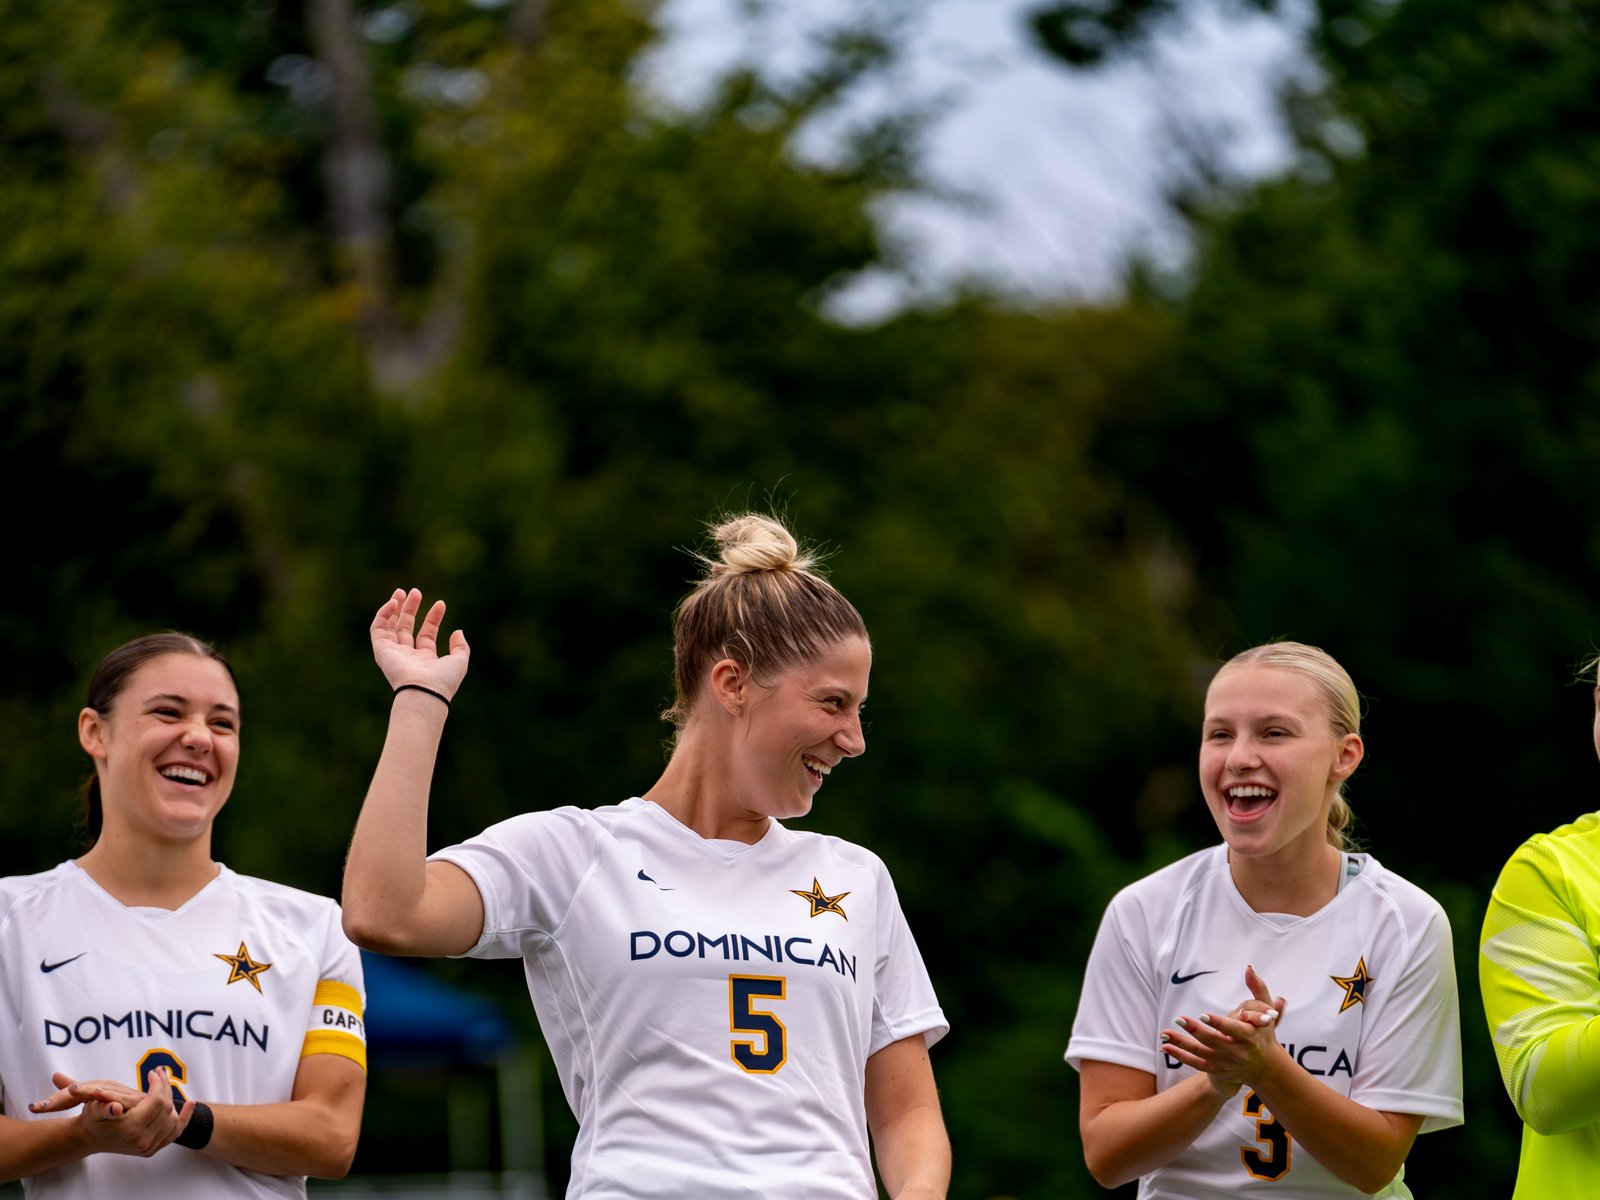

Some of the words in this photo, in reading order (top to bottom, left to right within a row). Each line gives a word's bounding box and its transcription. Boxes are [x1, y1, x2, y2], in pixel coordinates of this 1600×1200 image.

[630, 930, 856, 984] DOMINICAN
[44, 1009, 269, 1053] DOMINICAN
[728, 973, 787, 1075] 5
[1240, 1089, 1293, 1183] 3
